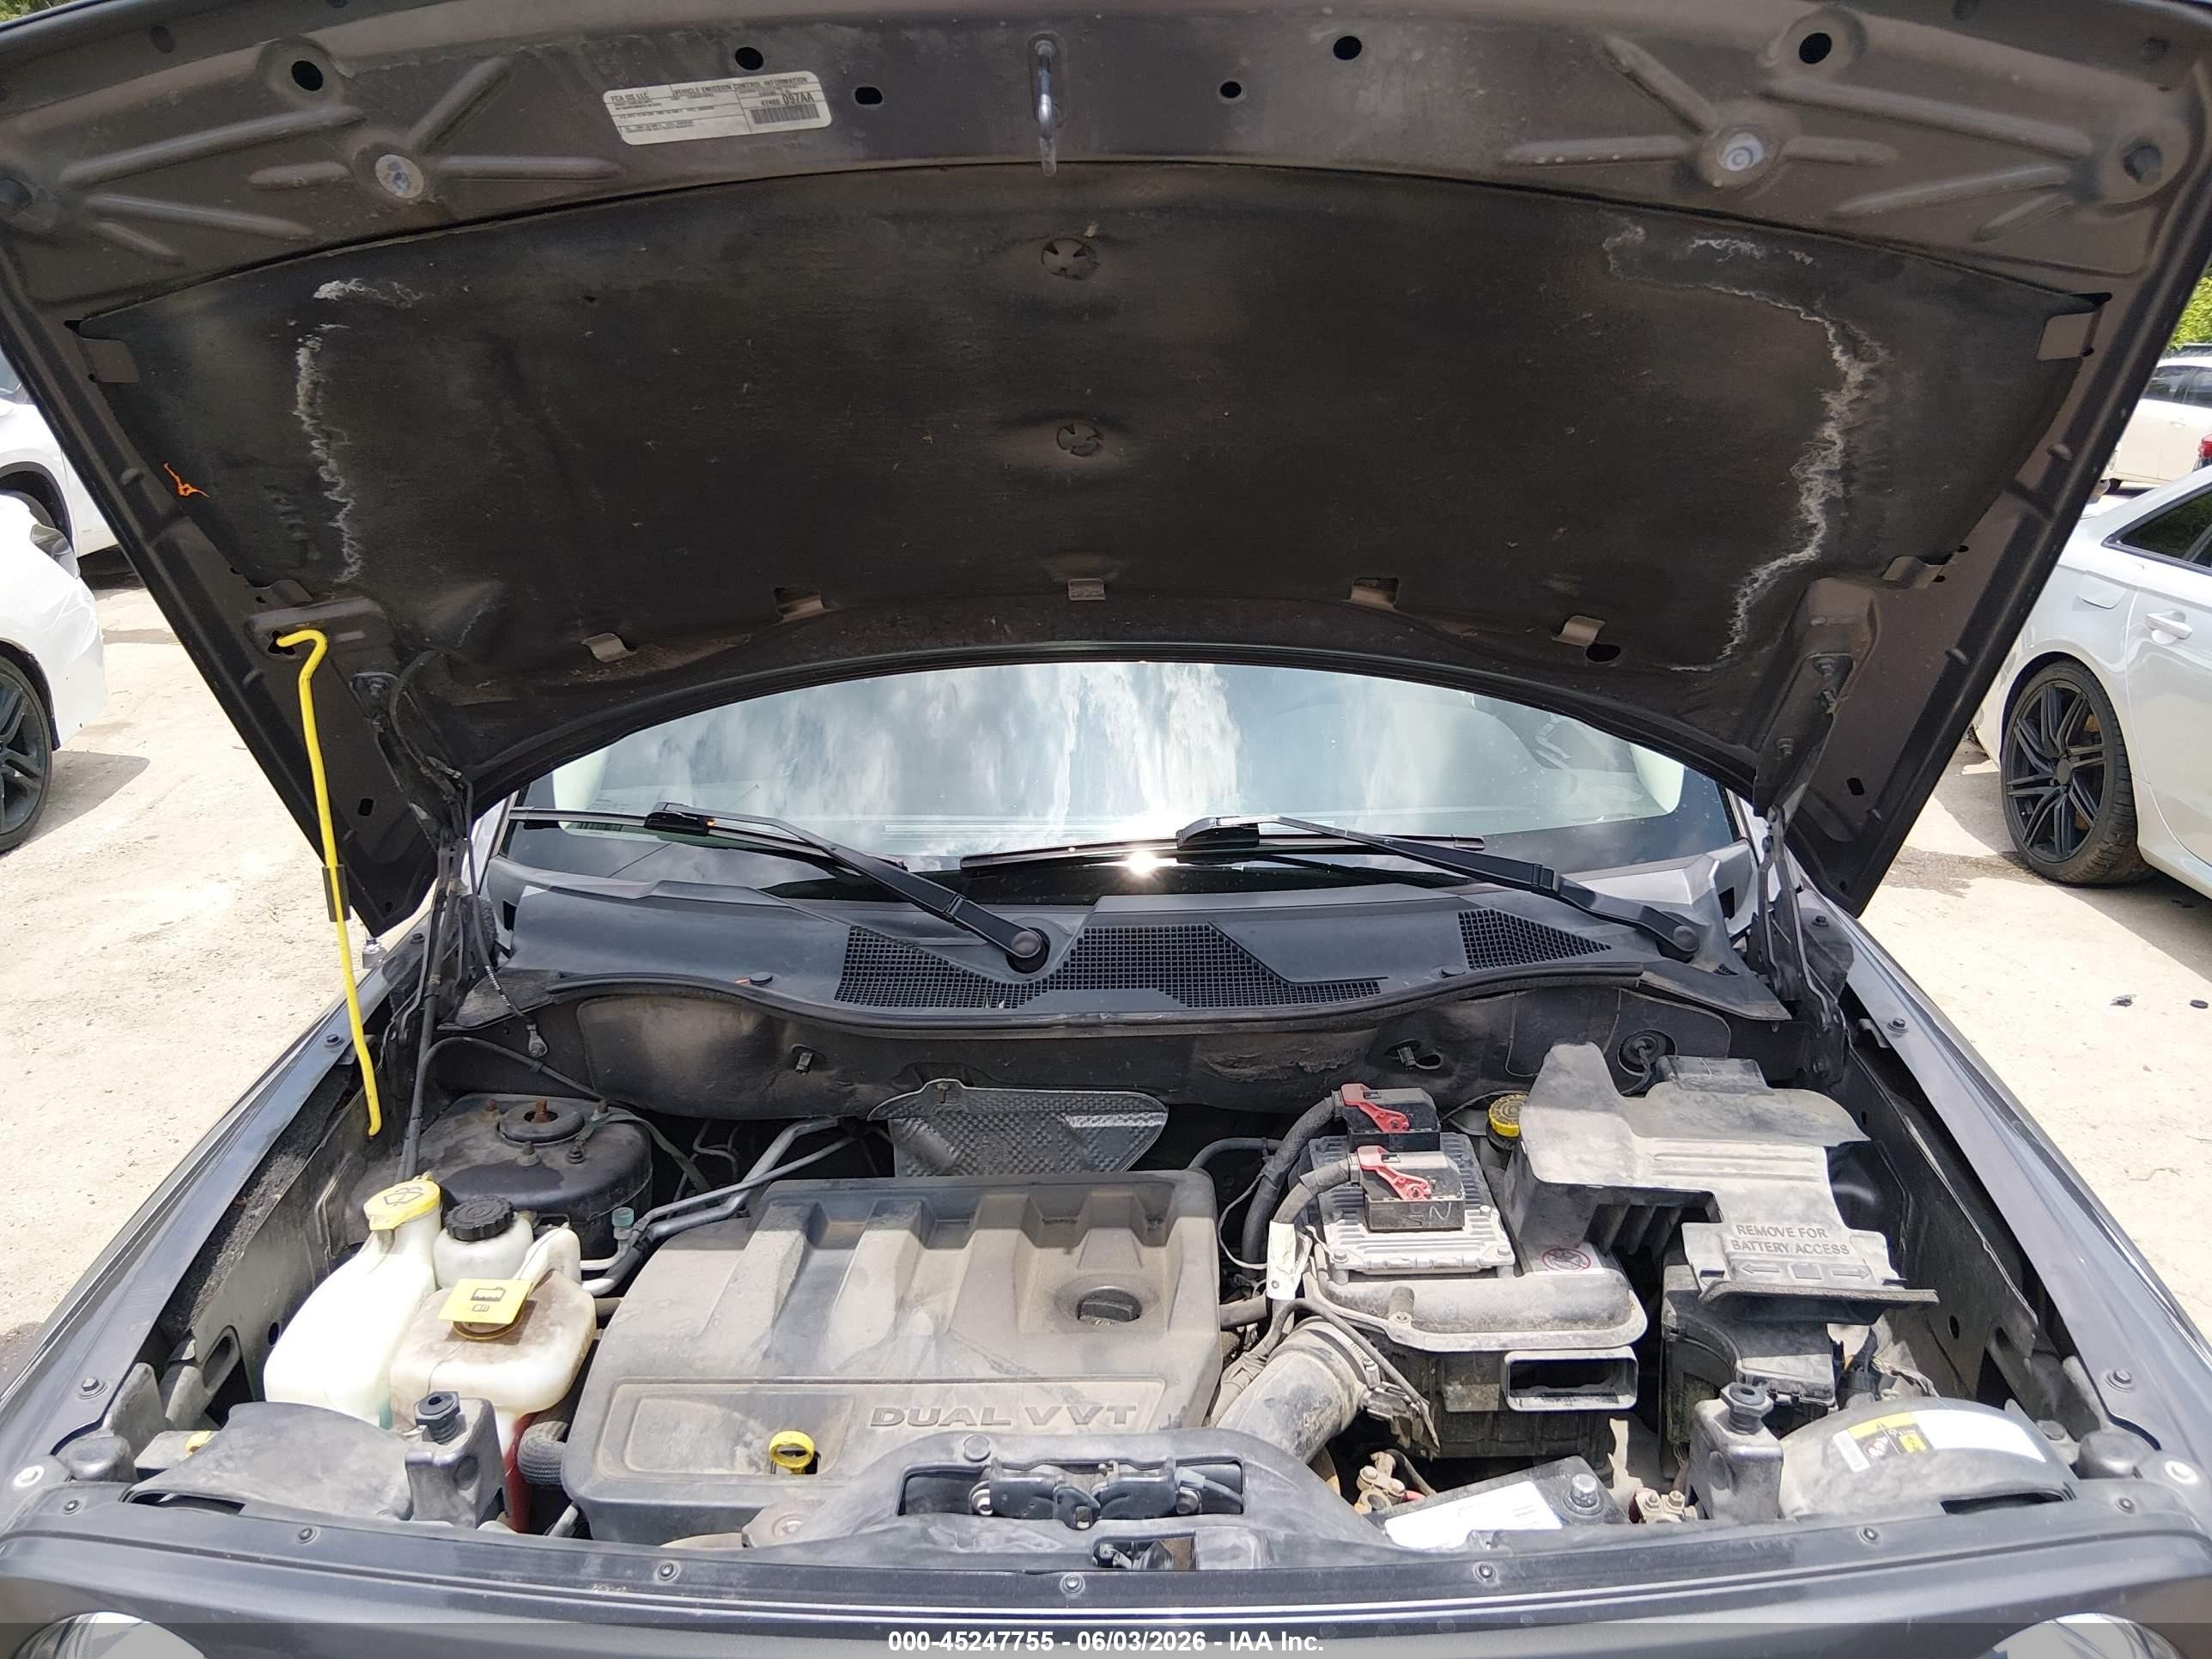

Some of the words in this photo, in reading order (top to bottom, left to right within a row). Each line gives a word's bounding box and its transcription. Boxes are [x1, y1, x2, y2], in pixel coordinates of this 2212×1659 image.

[673, 88, 700, 96] VEHICLE
[702, 84, 732, 93] EMISSION
[733, 82, 763, 90] CONTROL
[764, 76, 808, 86] INFORMATION
[611, 93, 625, 102] FCA
[636, 91, 649, 100] LLC
[781, 91, 816, 105] 097AA
[1735, 1224, 1796, 1238] REMOVE
[1798, 1227, 1828, 1239] FOR
[1730, 1239, 1790, 1254] BATTERY
[1795, 1243, 1850, 1255] ACCESS
[869, 1407, 1012, 1427] DUAL
[1024, 1405, 1138, 1426] VVT
